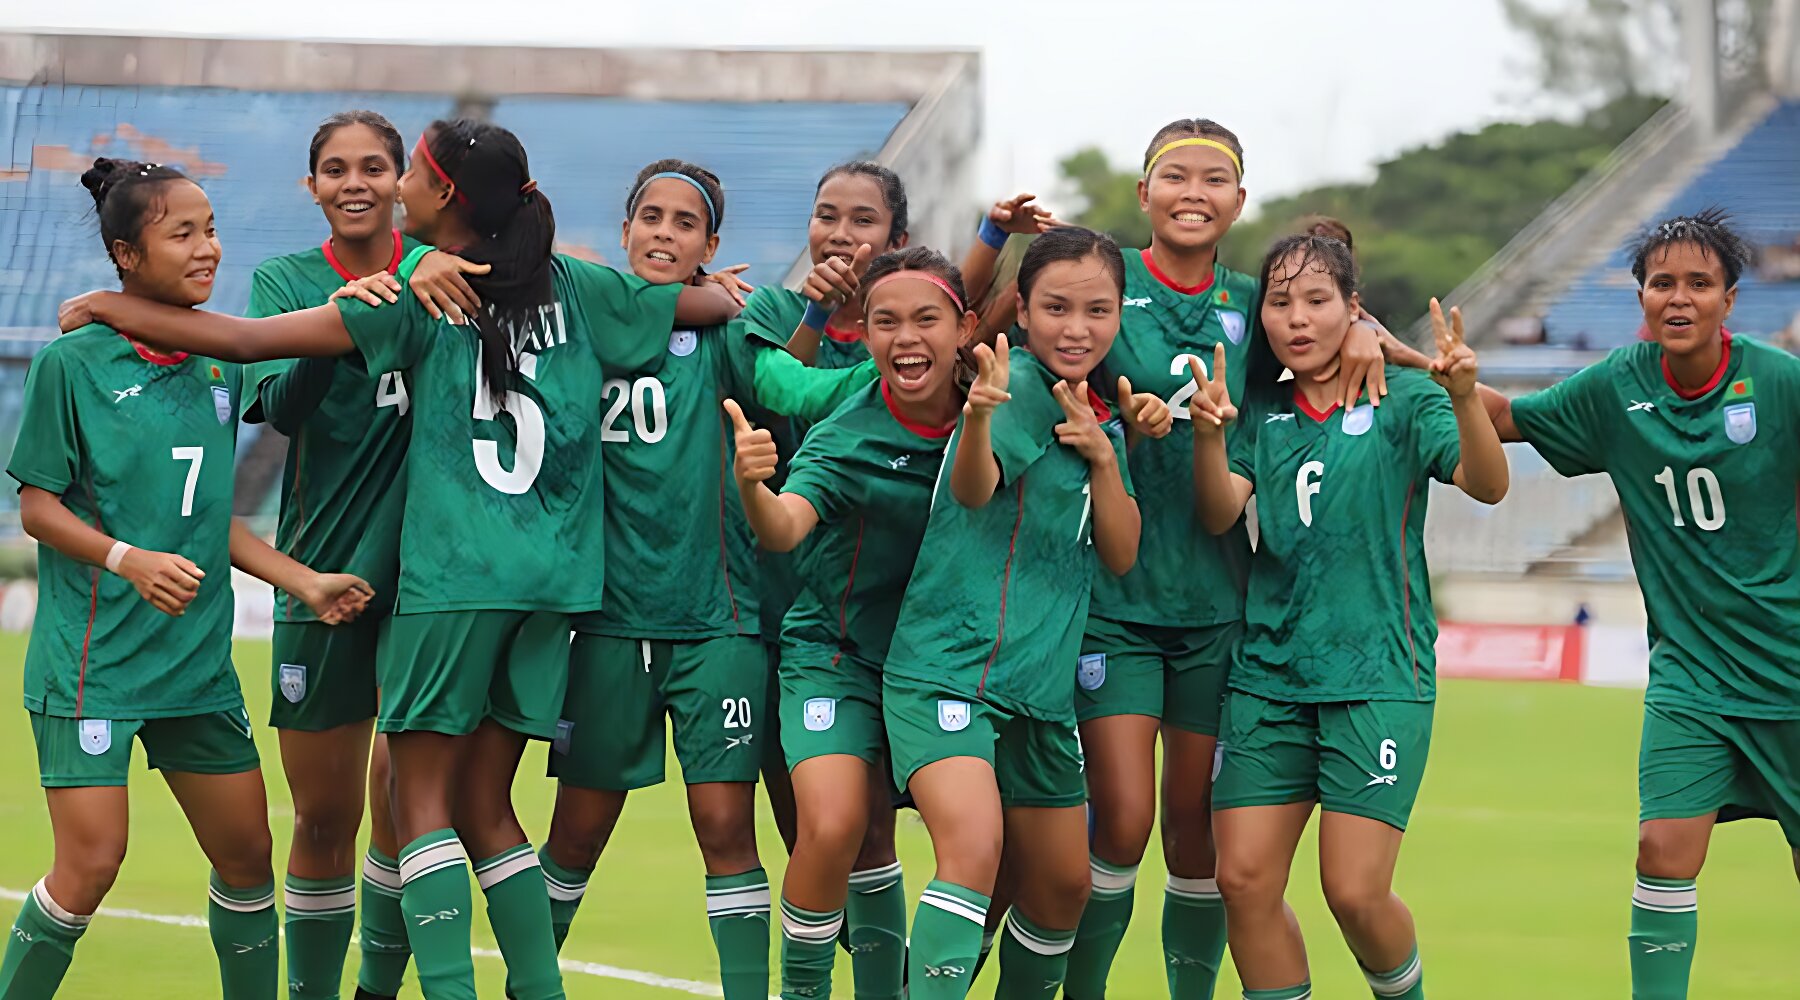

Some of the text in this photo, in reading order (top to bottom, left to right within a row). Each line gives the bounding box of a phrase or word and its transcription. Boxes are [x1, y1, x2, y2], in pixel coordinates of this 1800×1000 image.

[376, 371, 409, 416] 4
[473, 339, 545, 495] 5
[601, 377, 667, 443] 20
[1166, 354, 1207, 420] 2
[172, 447, 203, 516] 7
[1655, 466, 1726, 531] 10
[722, 697, 751, 728] 20
[1380, 739, 1396, 770] 6
